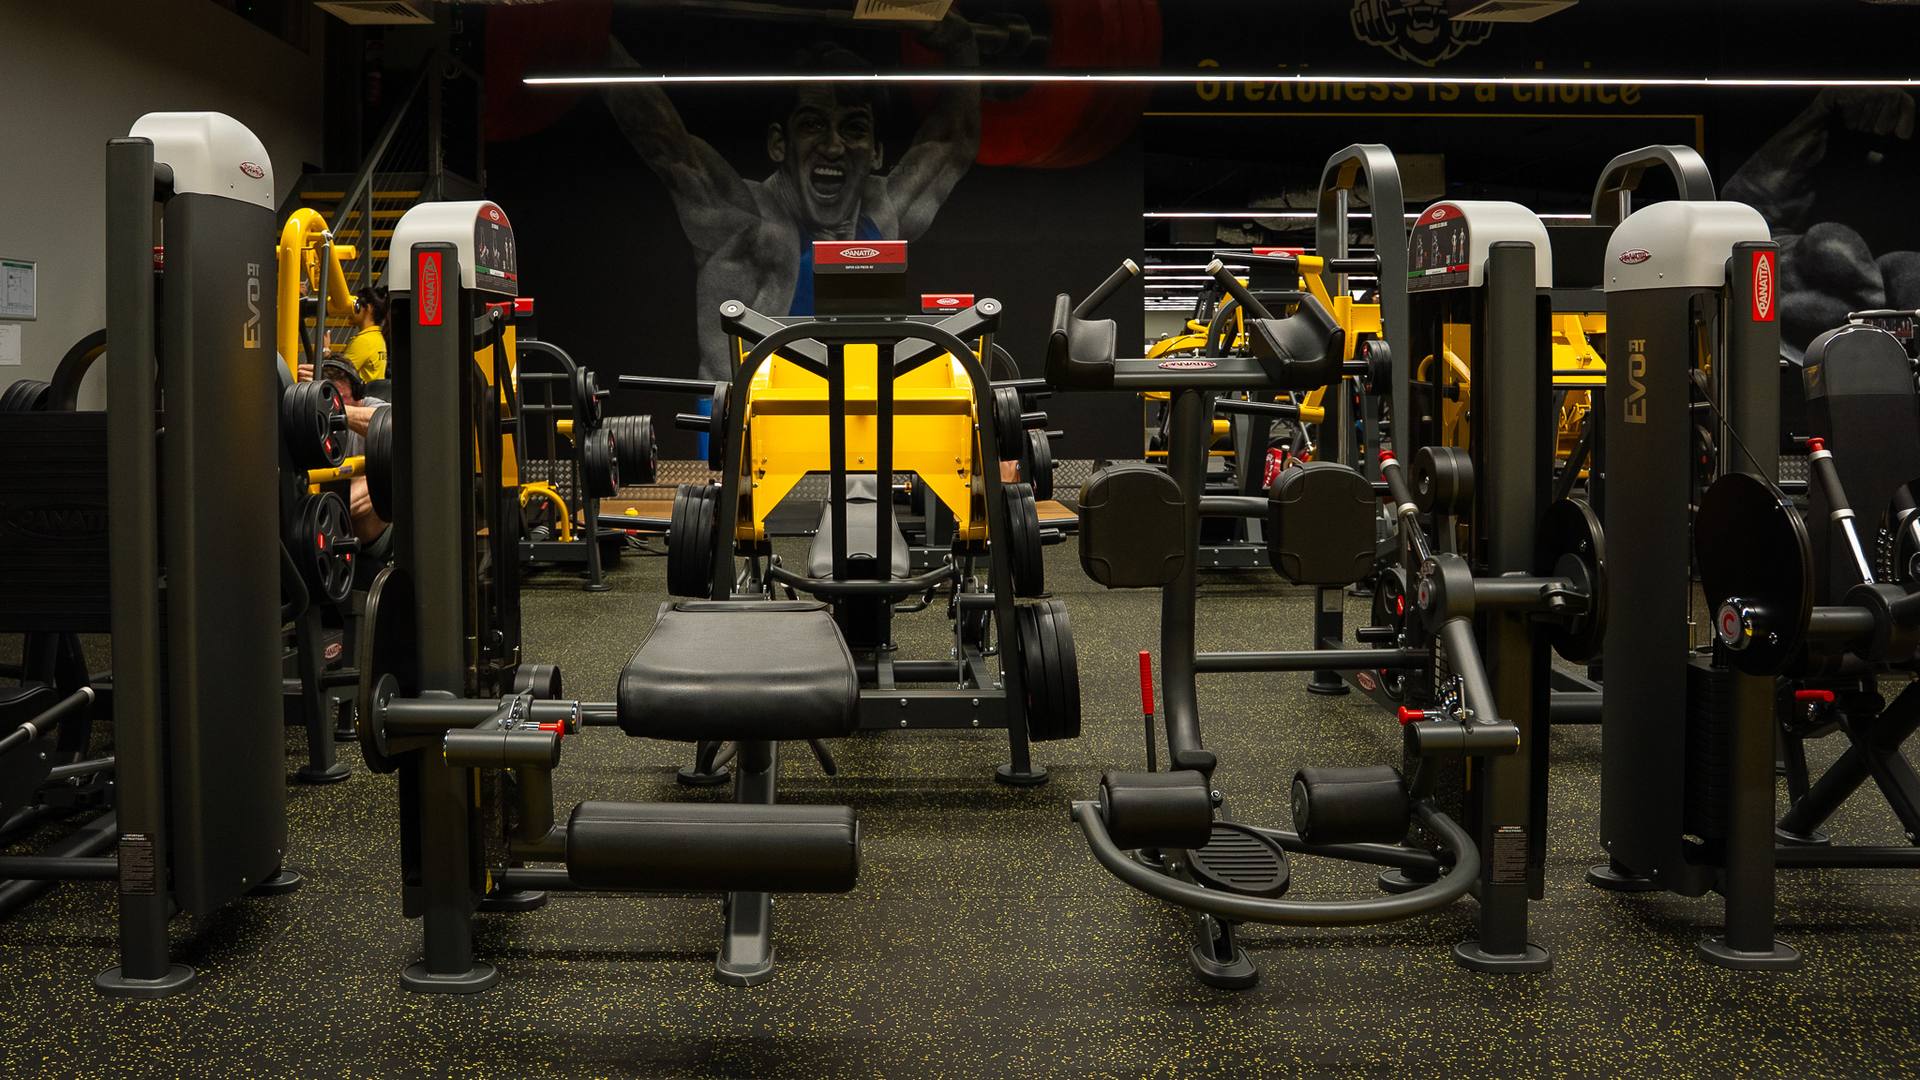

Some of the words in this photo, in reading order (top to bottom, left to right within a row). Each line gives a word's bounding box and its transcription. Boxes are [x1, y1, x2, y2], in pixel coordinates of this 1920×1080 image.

[844, 249, 877, 257] PANATTA
[423, 260, 437, 312] PANATTA
[1757, 258, 1769, 312] PANATTA
